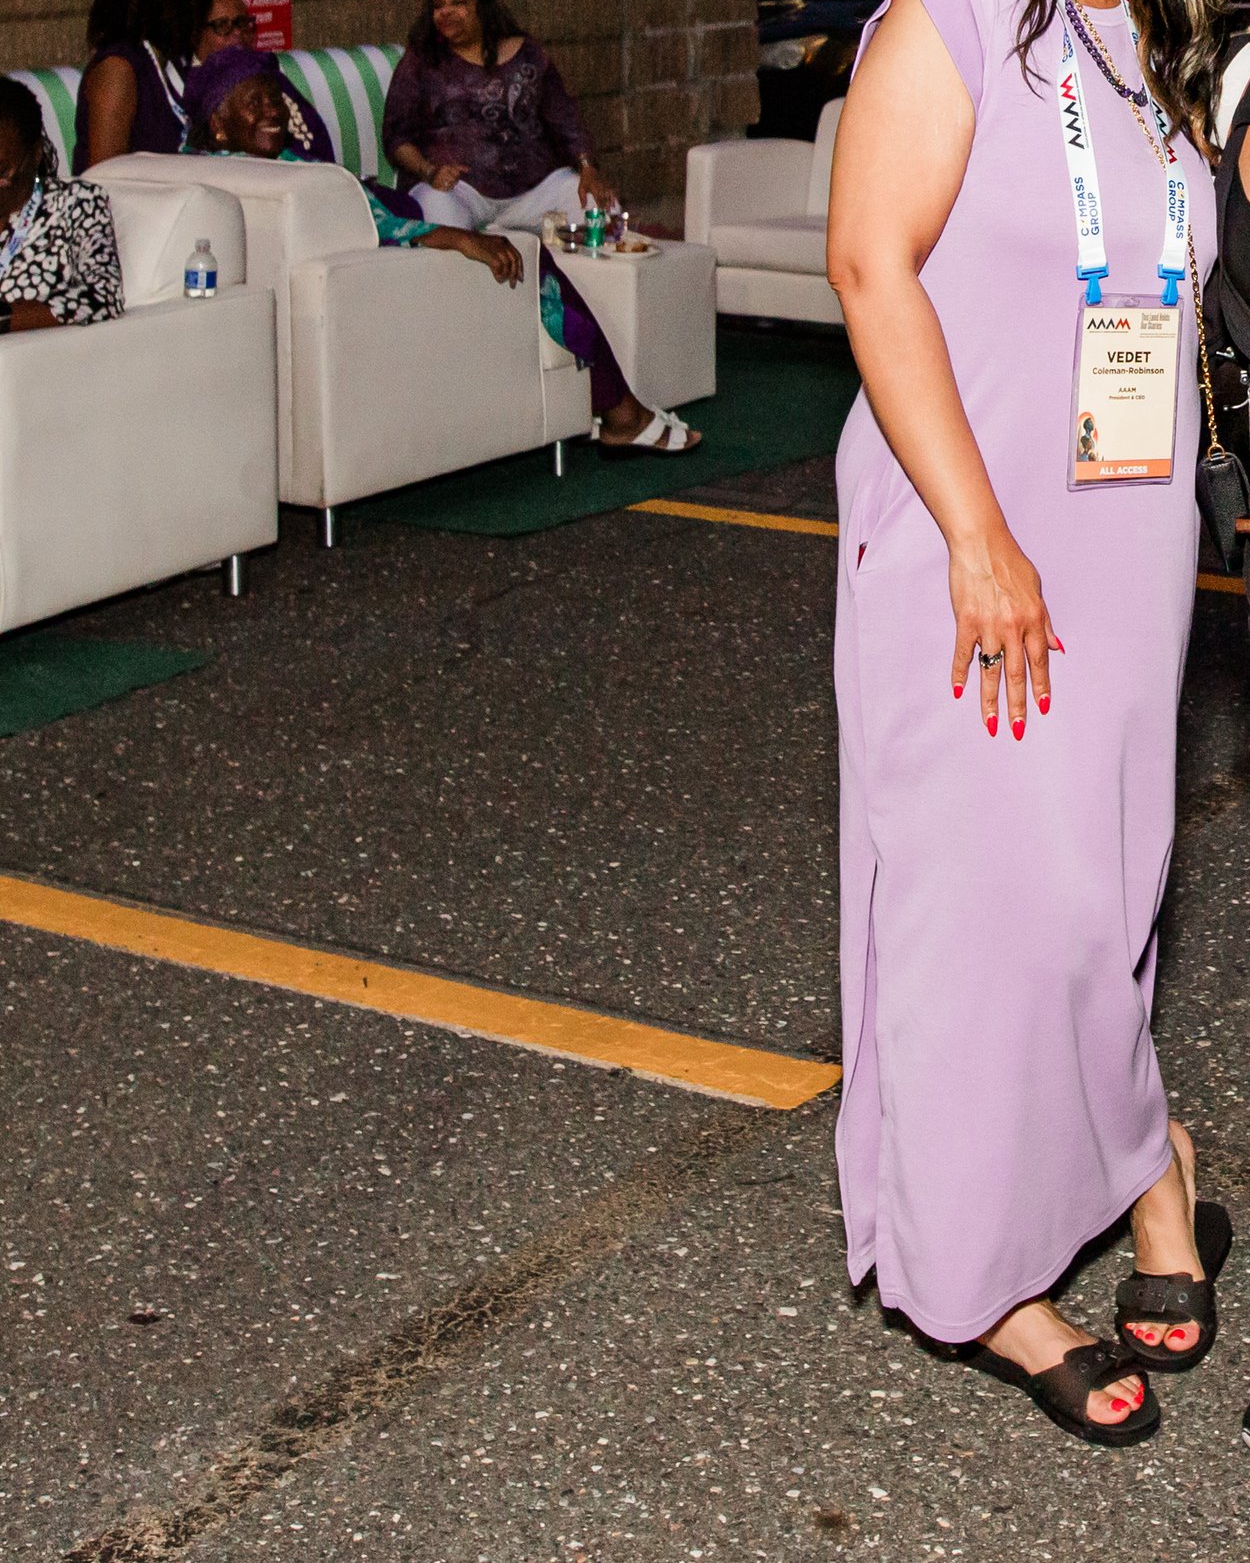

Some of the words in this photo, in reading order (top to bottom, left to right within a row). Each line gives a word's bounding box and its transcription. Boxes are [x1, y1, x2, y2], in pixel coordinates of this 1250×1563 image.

[1168, 179, 1176, 222] GROUP
[1088, 192, 1100, 236] GROUP
[1107, 351, 1151, 363] VEDET
[1092, 367, 1165, 375] Coleman-Robinson
[1099, 467, 1115, 475] ALL
[1117, 466, 1148, 474] ACCESS
